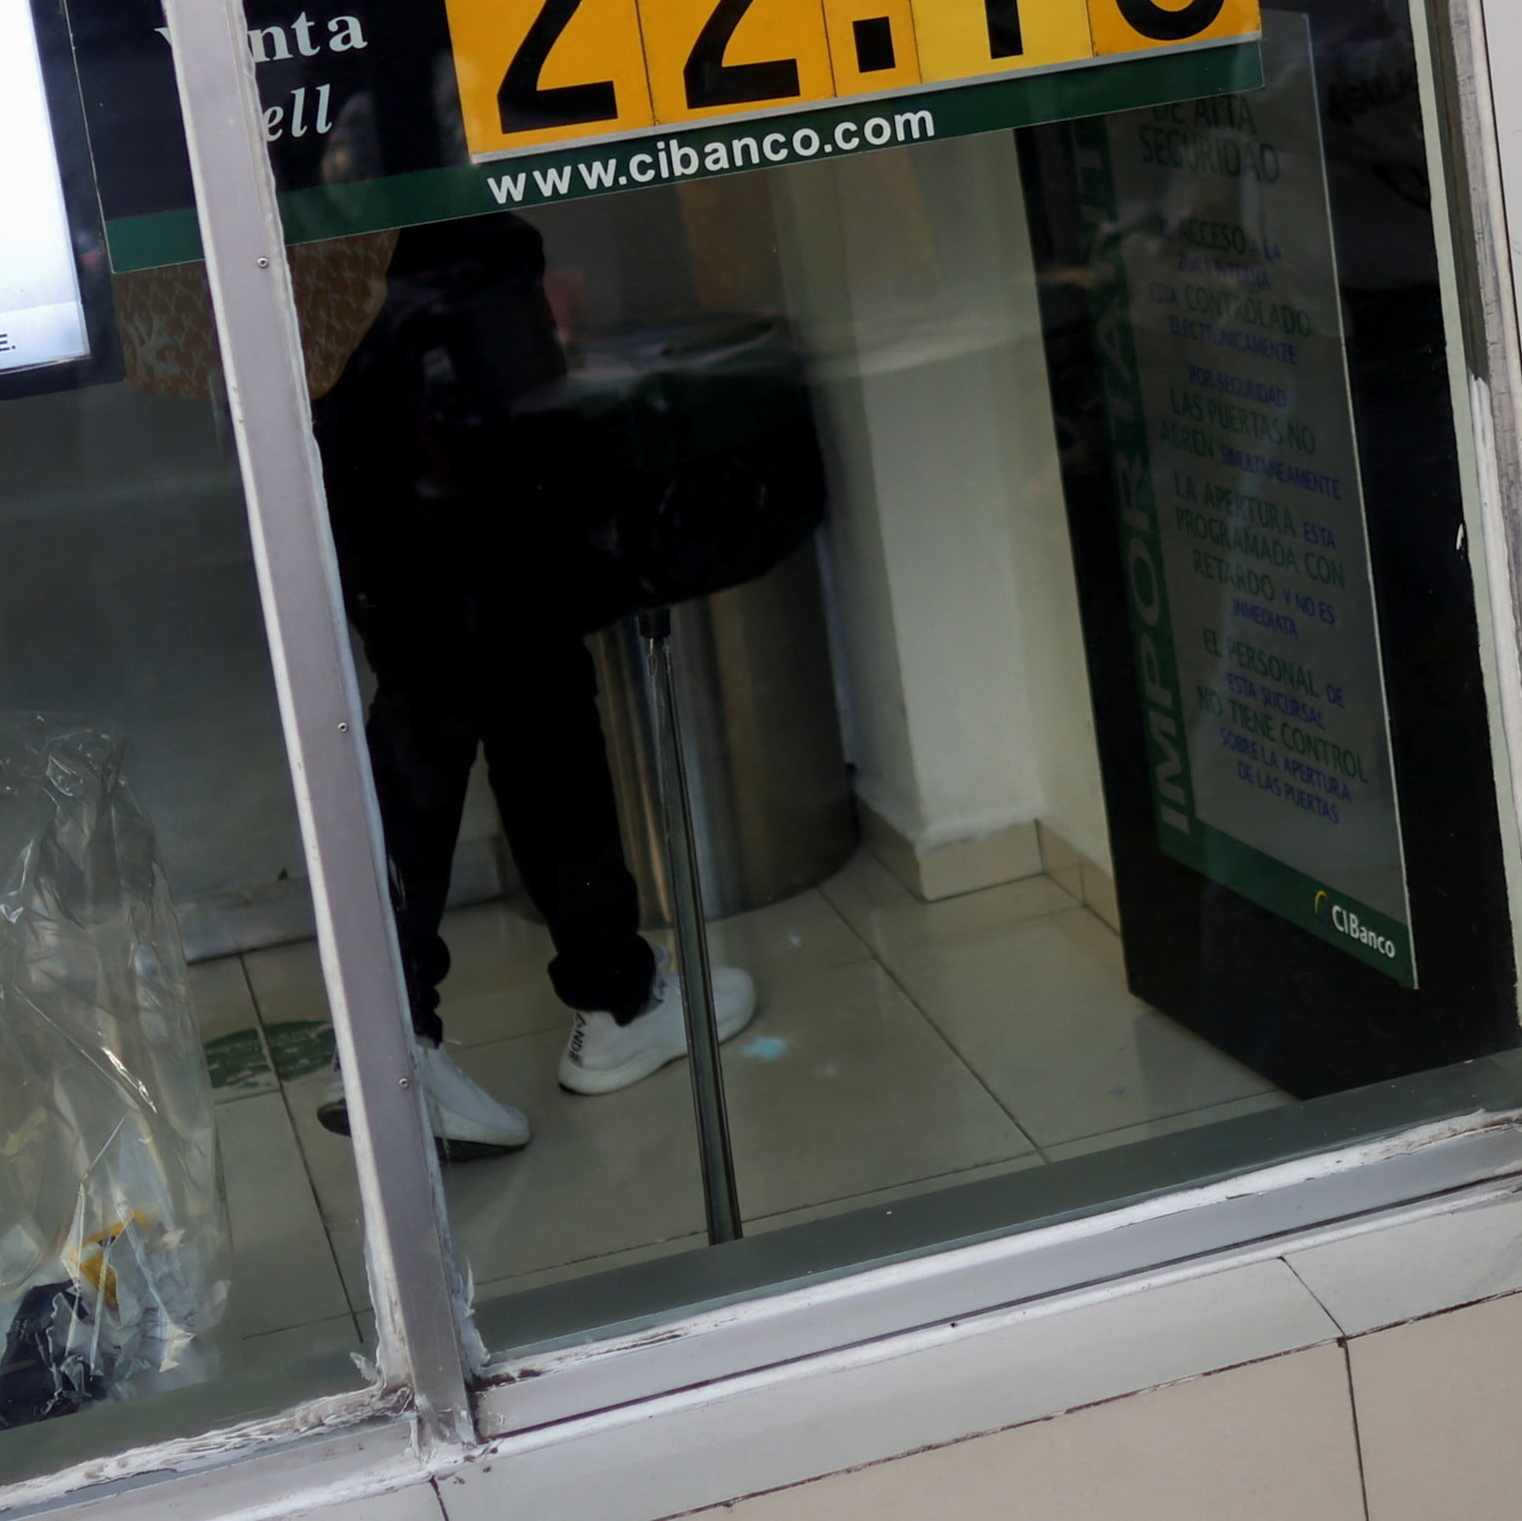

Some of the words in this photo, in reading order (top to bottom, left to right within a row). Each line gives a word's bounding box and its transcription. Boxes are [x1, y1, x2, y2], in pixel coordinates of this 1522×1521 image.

[154, 11, 369, 64] nta
[262, 83, 333, 142] ell
[487, 109, 935, 205] www.cibanco.com
[1139, 126, 1280, 183] SEGURIDAD
[1185, 283, 1311, 338] CONTROLADO
[1170, 388, 1203, 422] LAS
[1208, 398, 1284, 446] PUERTAS
[1288, 421, 1316, 455] NO
[1174, 471, 1198, 504] LA
[1204, 482, 1297, 537] APERTURA
[1303, 521, 1337, 550] ESTA
[1176, 506, 1299, 574] PROGRAMADA
[1305, 550, 1345, 591] CON
[1192, 548, 1275, 603] RETARDO
[1282, 588, 1292, 606] Y
[1295, 593, 1315, 617] NO
[1319, 601, 1336, 625] ES
[1232, 598, 1299, 638] INMEDIATA
[1203, 627, 1223, 659] EL
[1227, 637, 1320, 699] PERSONAL
[1326, 683, 1345, 709] DE
[1197, 685, 1223, 718] NO
[1228, 697, 1276, 743] TIENE
[1281, 722, 1369, 784] CONTROL
[1226, 672, 1257, 701] ESTA
[1261, 685, 1326, 731] SUCURSAL
[1220, 727, 1259, 761] SOBRE
[1262, 745, 1279, 770] LA
[1284, 755, 1352, 804] APERTURA
[1237, 760, 1254, 785] DE
[1256, 768, 1282, 798] LAS
[1284, 782, 1339, 825] PUERTAS
[1332, 905, 1395, 958] CIBanco
